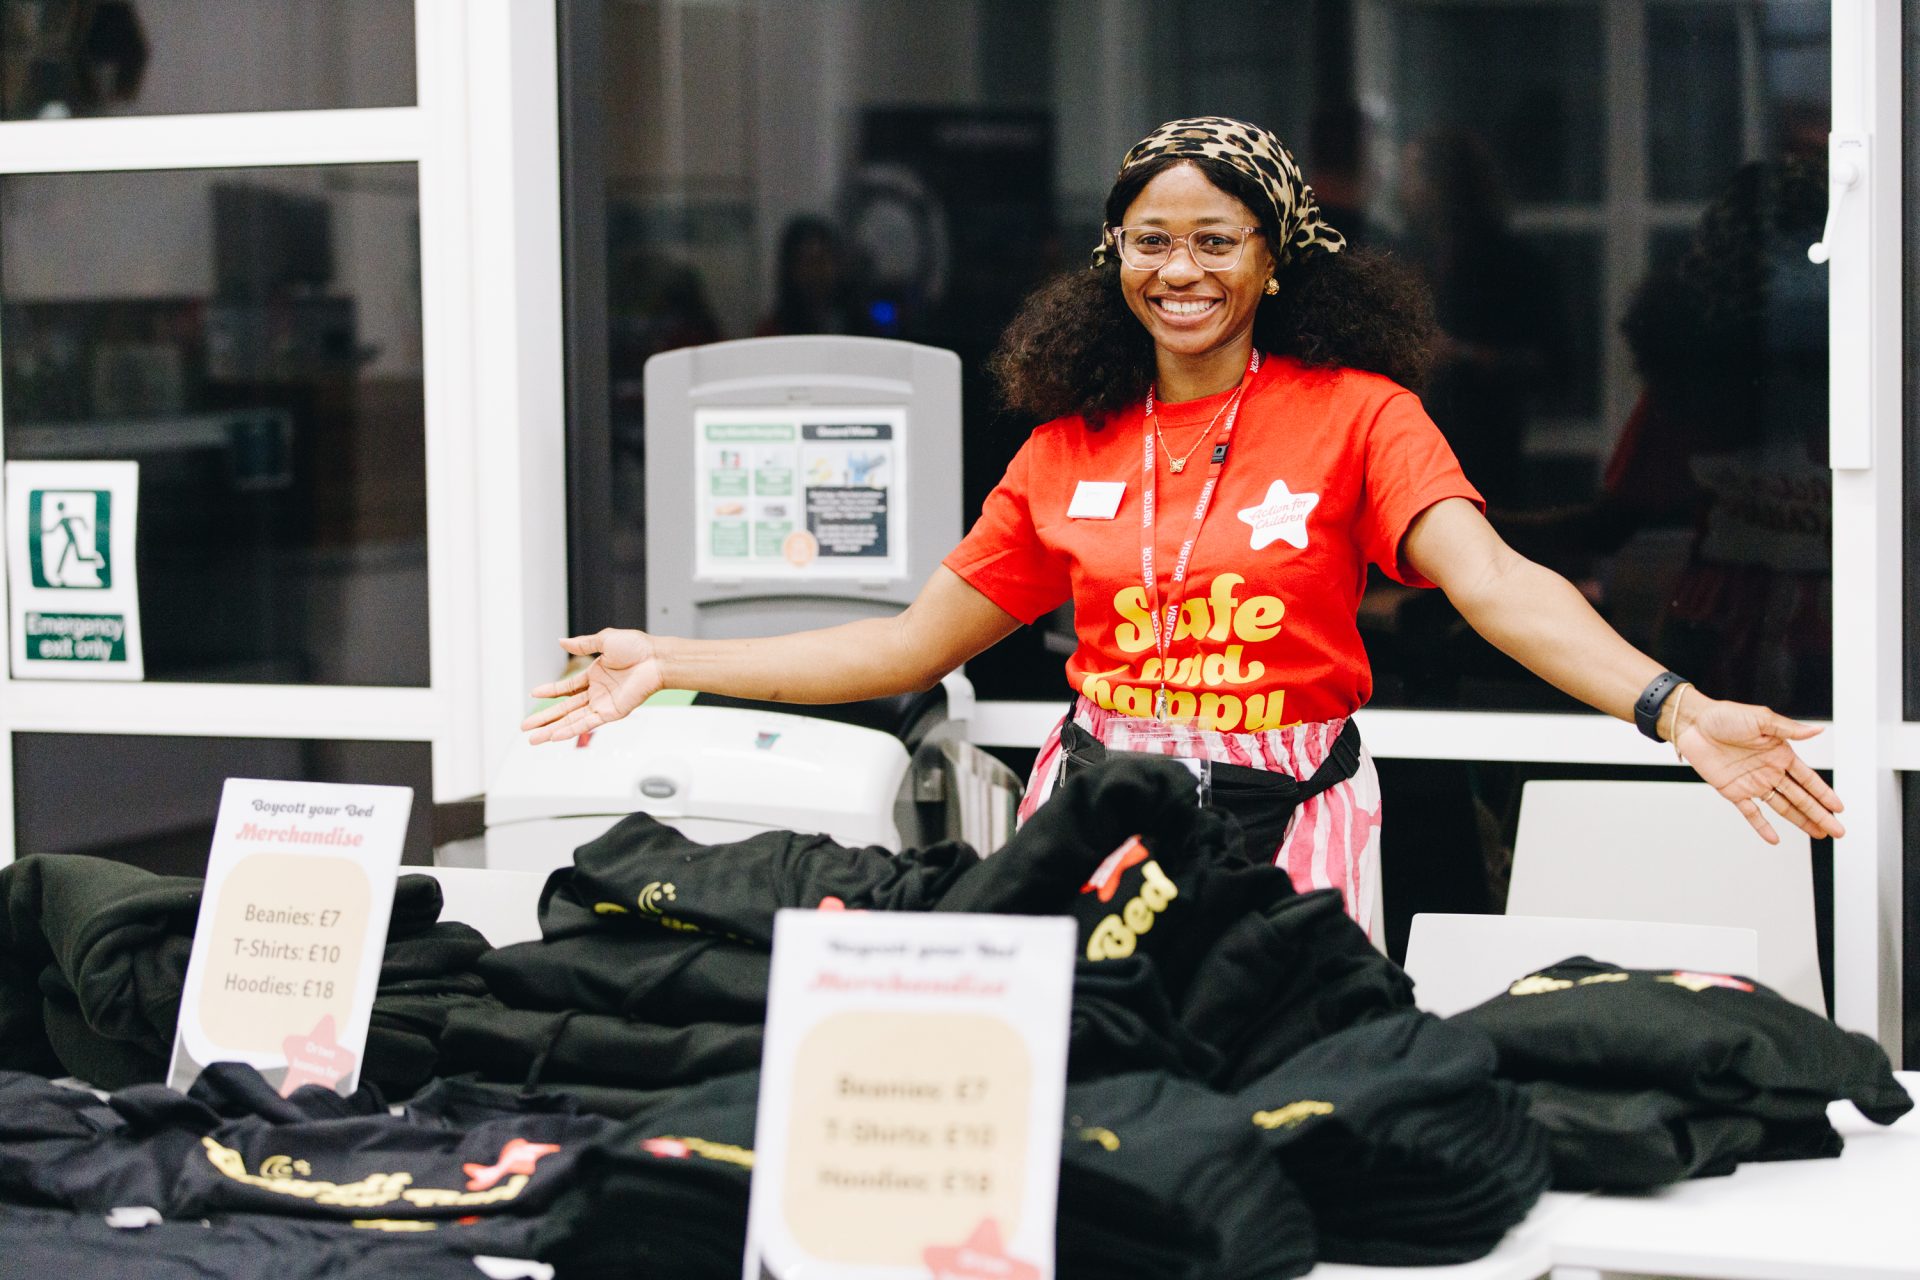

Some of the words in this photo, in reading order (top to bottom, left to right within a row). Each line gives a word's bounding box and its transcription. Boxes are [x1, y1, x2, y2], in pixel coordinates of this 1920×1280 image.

[1144, 433, 1154, 472] VISITOR
[1143, 489, 1153, 529] VISITOR
[1193, 479, 1214, 521] VISITOR
[1291, 498, 1309, 513] for
[1255, 513, 1304, 530] Children
[1143, 546, 1153, 589] VISITOR
[1173, 539, 1193, 582] VISITOR
[26, 613, 124, 642] Emergency
[1113, 572, 1286, 653] Safe
[1164, 605, 1178, 648] VISITOR
[39, 637, 73, 658] exit
[74, 637, 112, 661] only
[1139, 644, 1265, 687] and
[1079, 664, 1303, 735] happy
[251, 798, 305, 816] Boycott
[308, 804, 341, 819] your
[345, 804, 374, 818] Bed
[235, 823, 364, 847] Merchandise
[244, 903, 315, 926] Beanies:
[319, 909, 341, 928] £7
[233, 938, 303, 961] T-Shirts:
[308, 944, 341, 964] £10
[224, 972, 298, 997] Hoodies:
[303, 979, 335, 1000] £18
